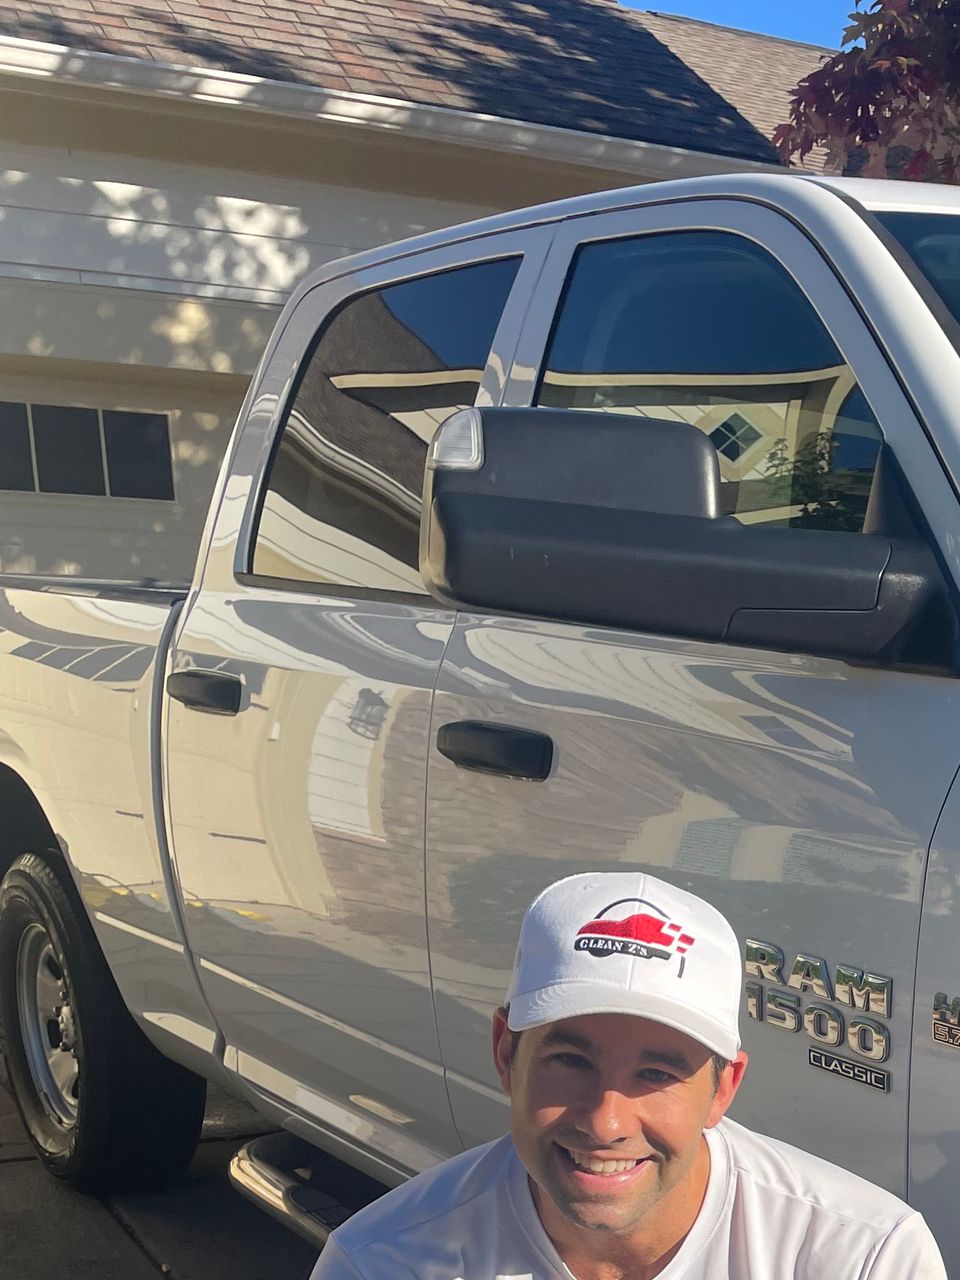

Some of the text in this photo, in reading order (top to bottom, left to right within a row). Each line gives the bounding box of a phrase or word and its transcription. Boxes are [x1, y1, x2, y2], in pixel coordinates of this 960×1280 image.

[579, 939, 624, 951] CLEAN
[745, 938, 893, 1018] RAM
[745, 982, 890, 1063] 1500
[810, 1048, 885, 1089] CLASSIC
